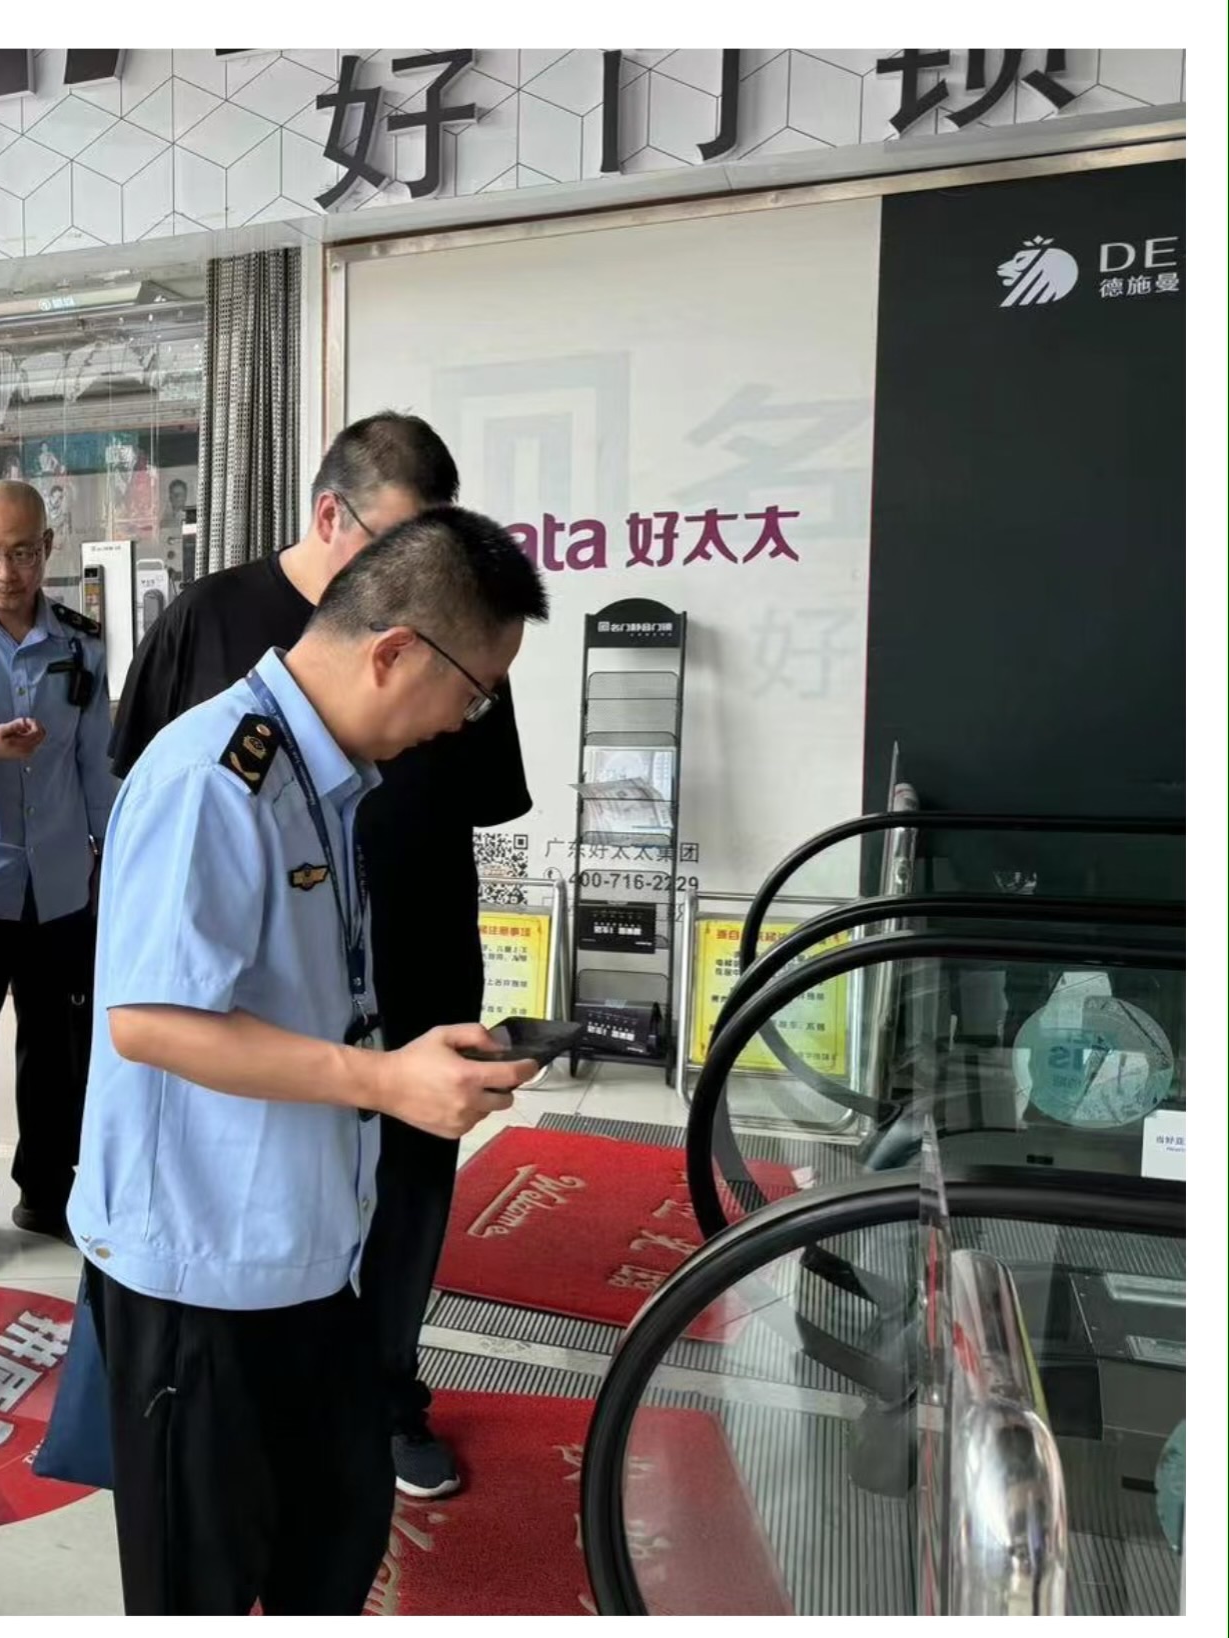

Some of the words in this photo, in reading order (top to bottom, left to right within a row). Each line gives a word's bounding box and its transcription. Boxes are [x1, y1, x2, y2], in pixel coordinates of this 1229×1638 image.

[1098, 272, 1180, 299] 德施曼
[624, 503, 801, 568] 好太太
[543, 837, 701, 864] 广东好太太集团
[569, 871, 700, 893] 400-716-2229
